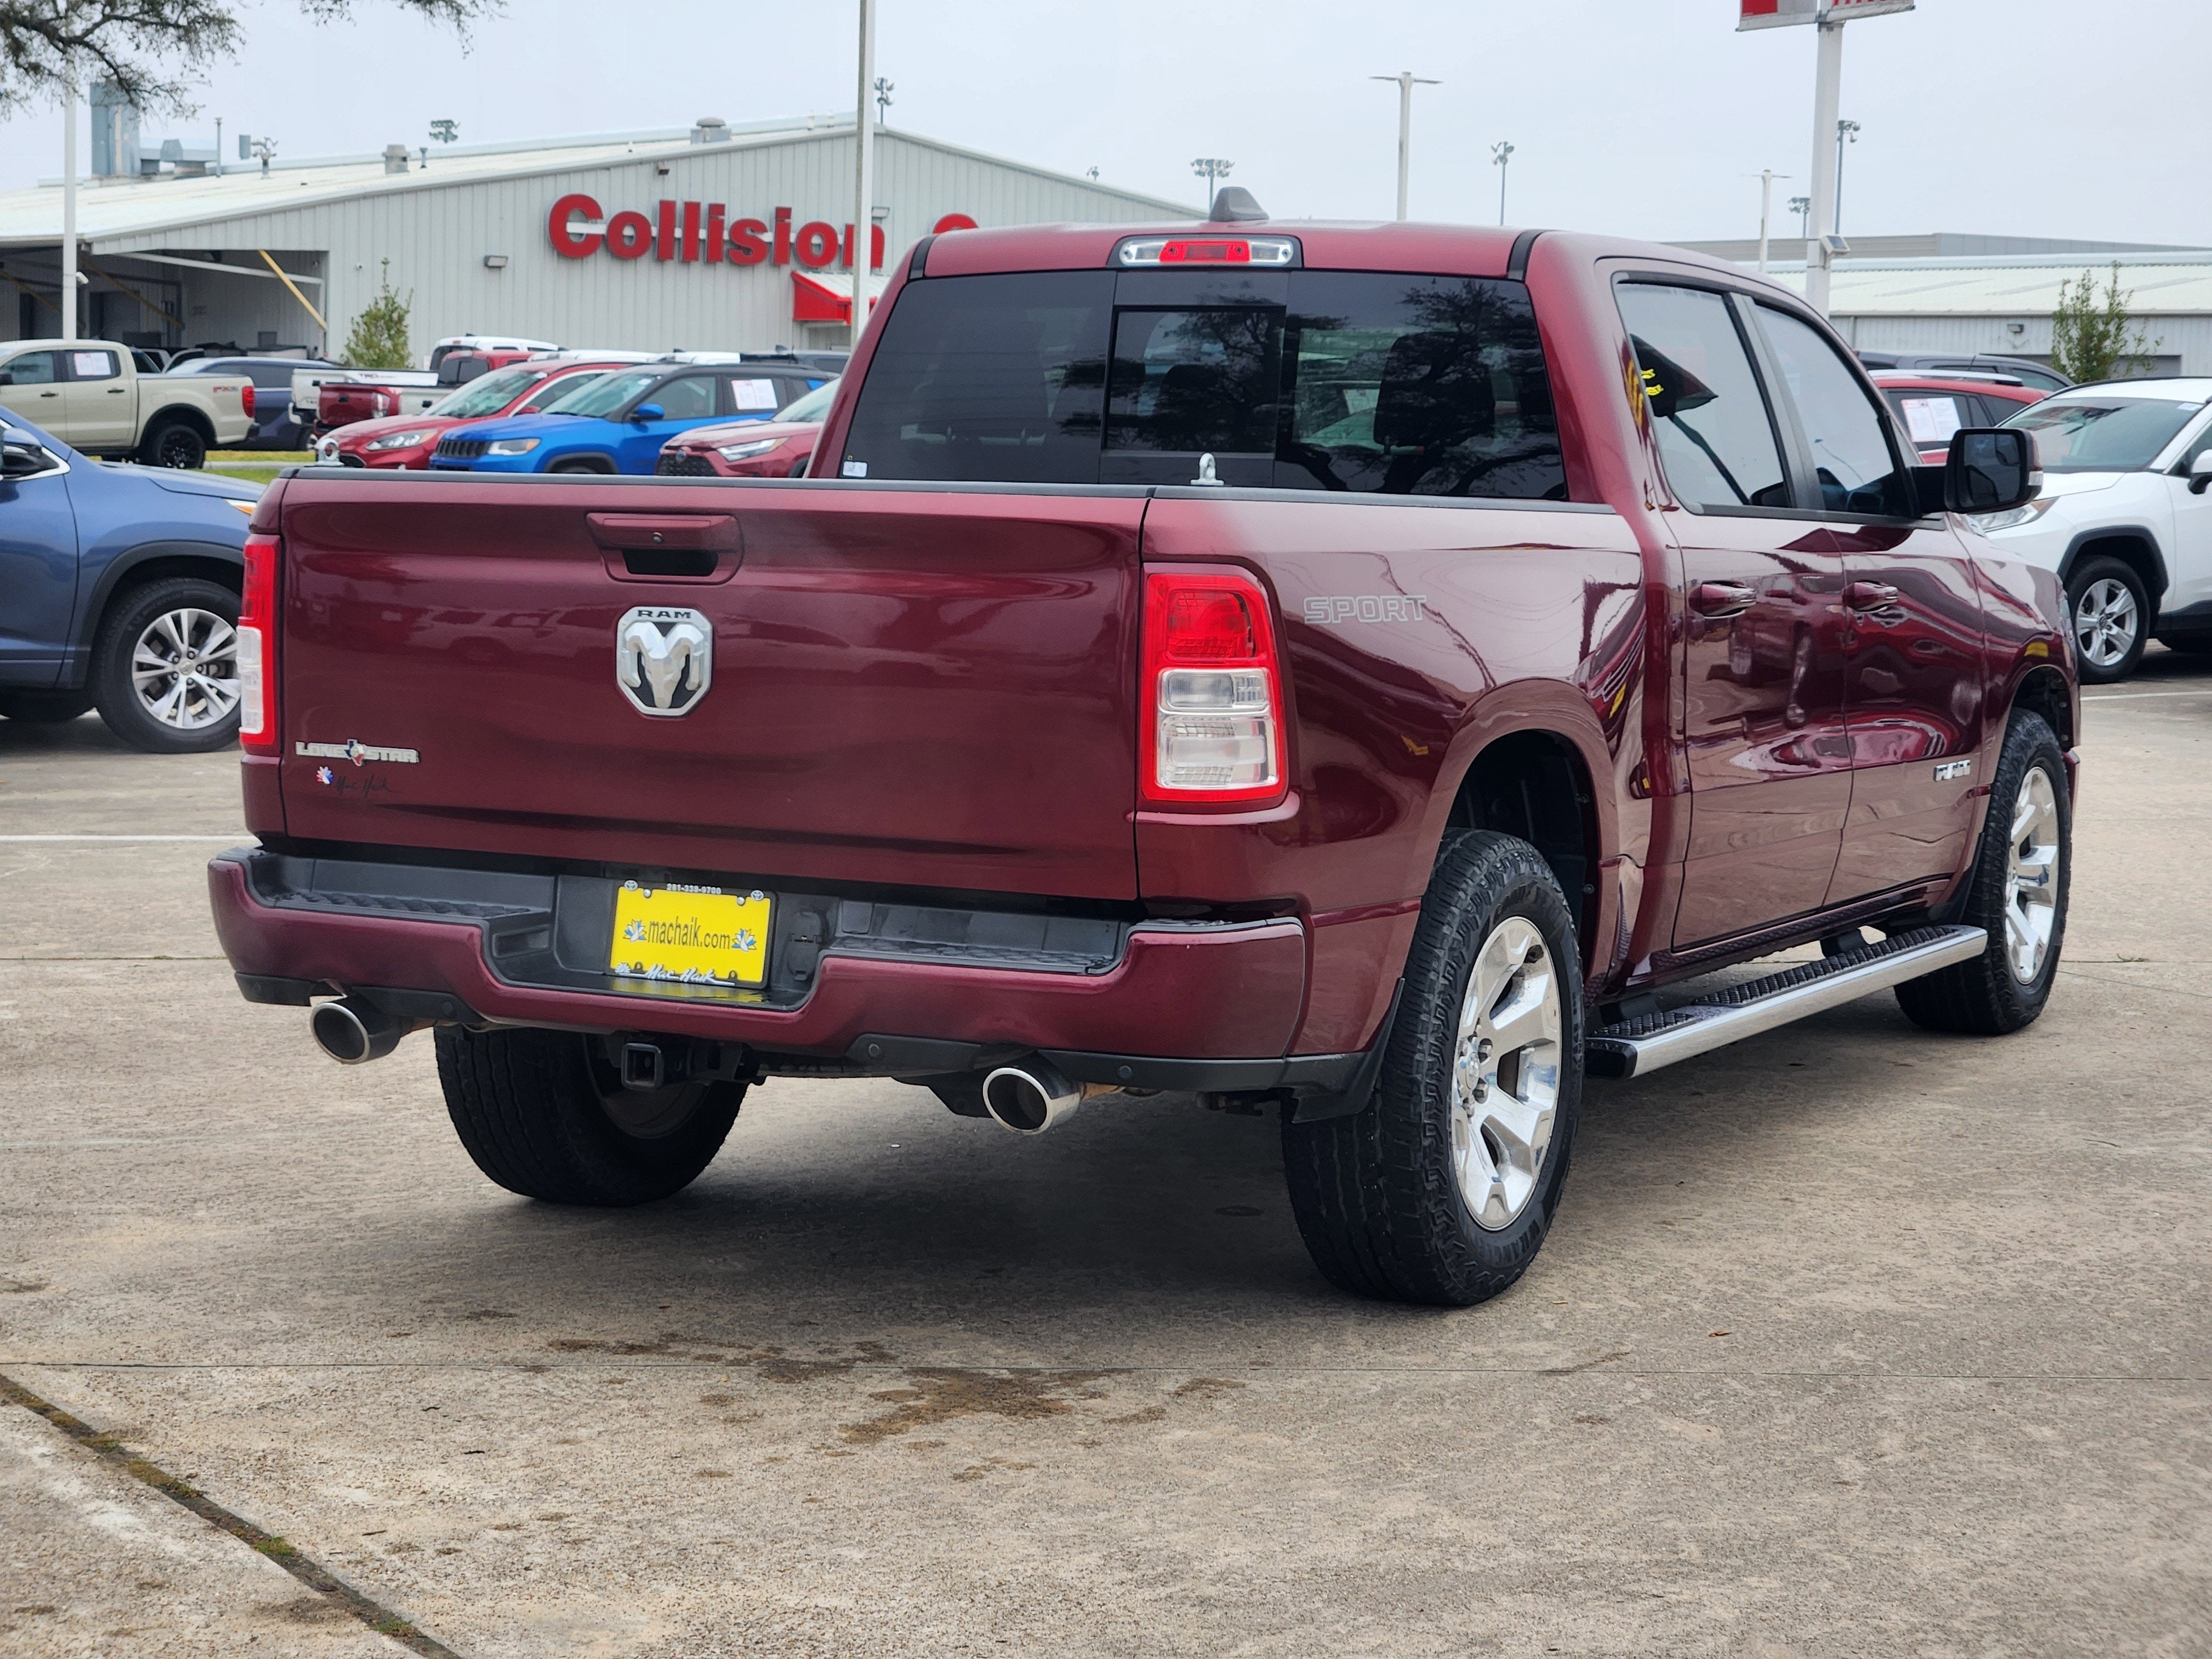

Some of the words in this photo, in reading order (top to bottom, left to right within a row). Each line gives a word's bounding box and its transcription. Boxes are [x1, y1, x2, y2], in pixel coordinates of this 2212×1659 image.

[549, 194, 885, 268] Collision
[638, 609, 691, 619] RAM
[1303, 595, 1427, 624] SPORT
[295, 742, 348, 759] LONE
[362, 745, 420, 763] STAR
[648, 916, 730, 950] machaik.com
[645, 964, 679, 980] Mac
[679, 967, 723, 984] Haik
